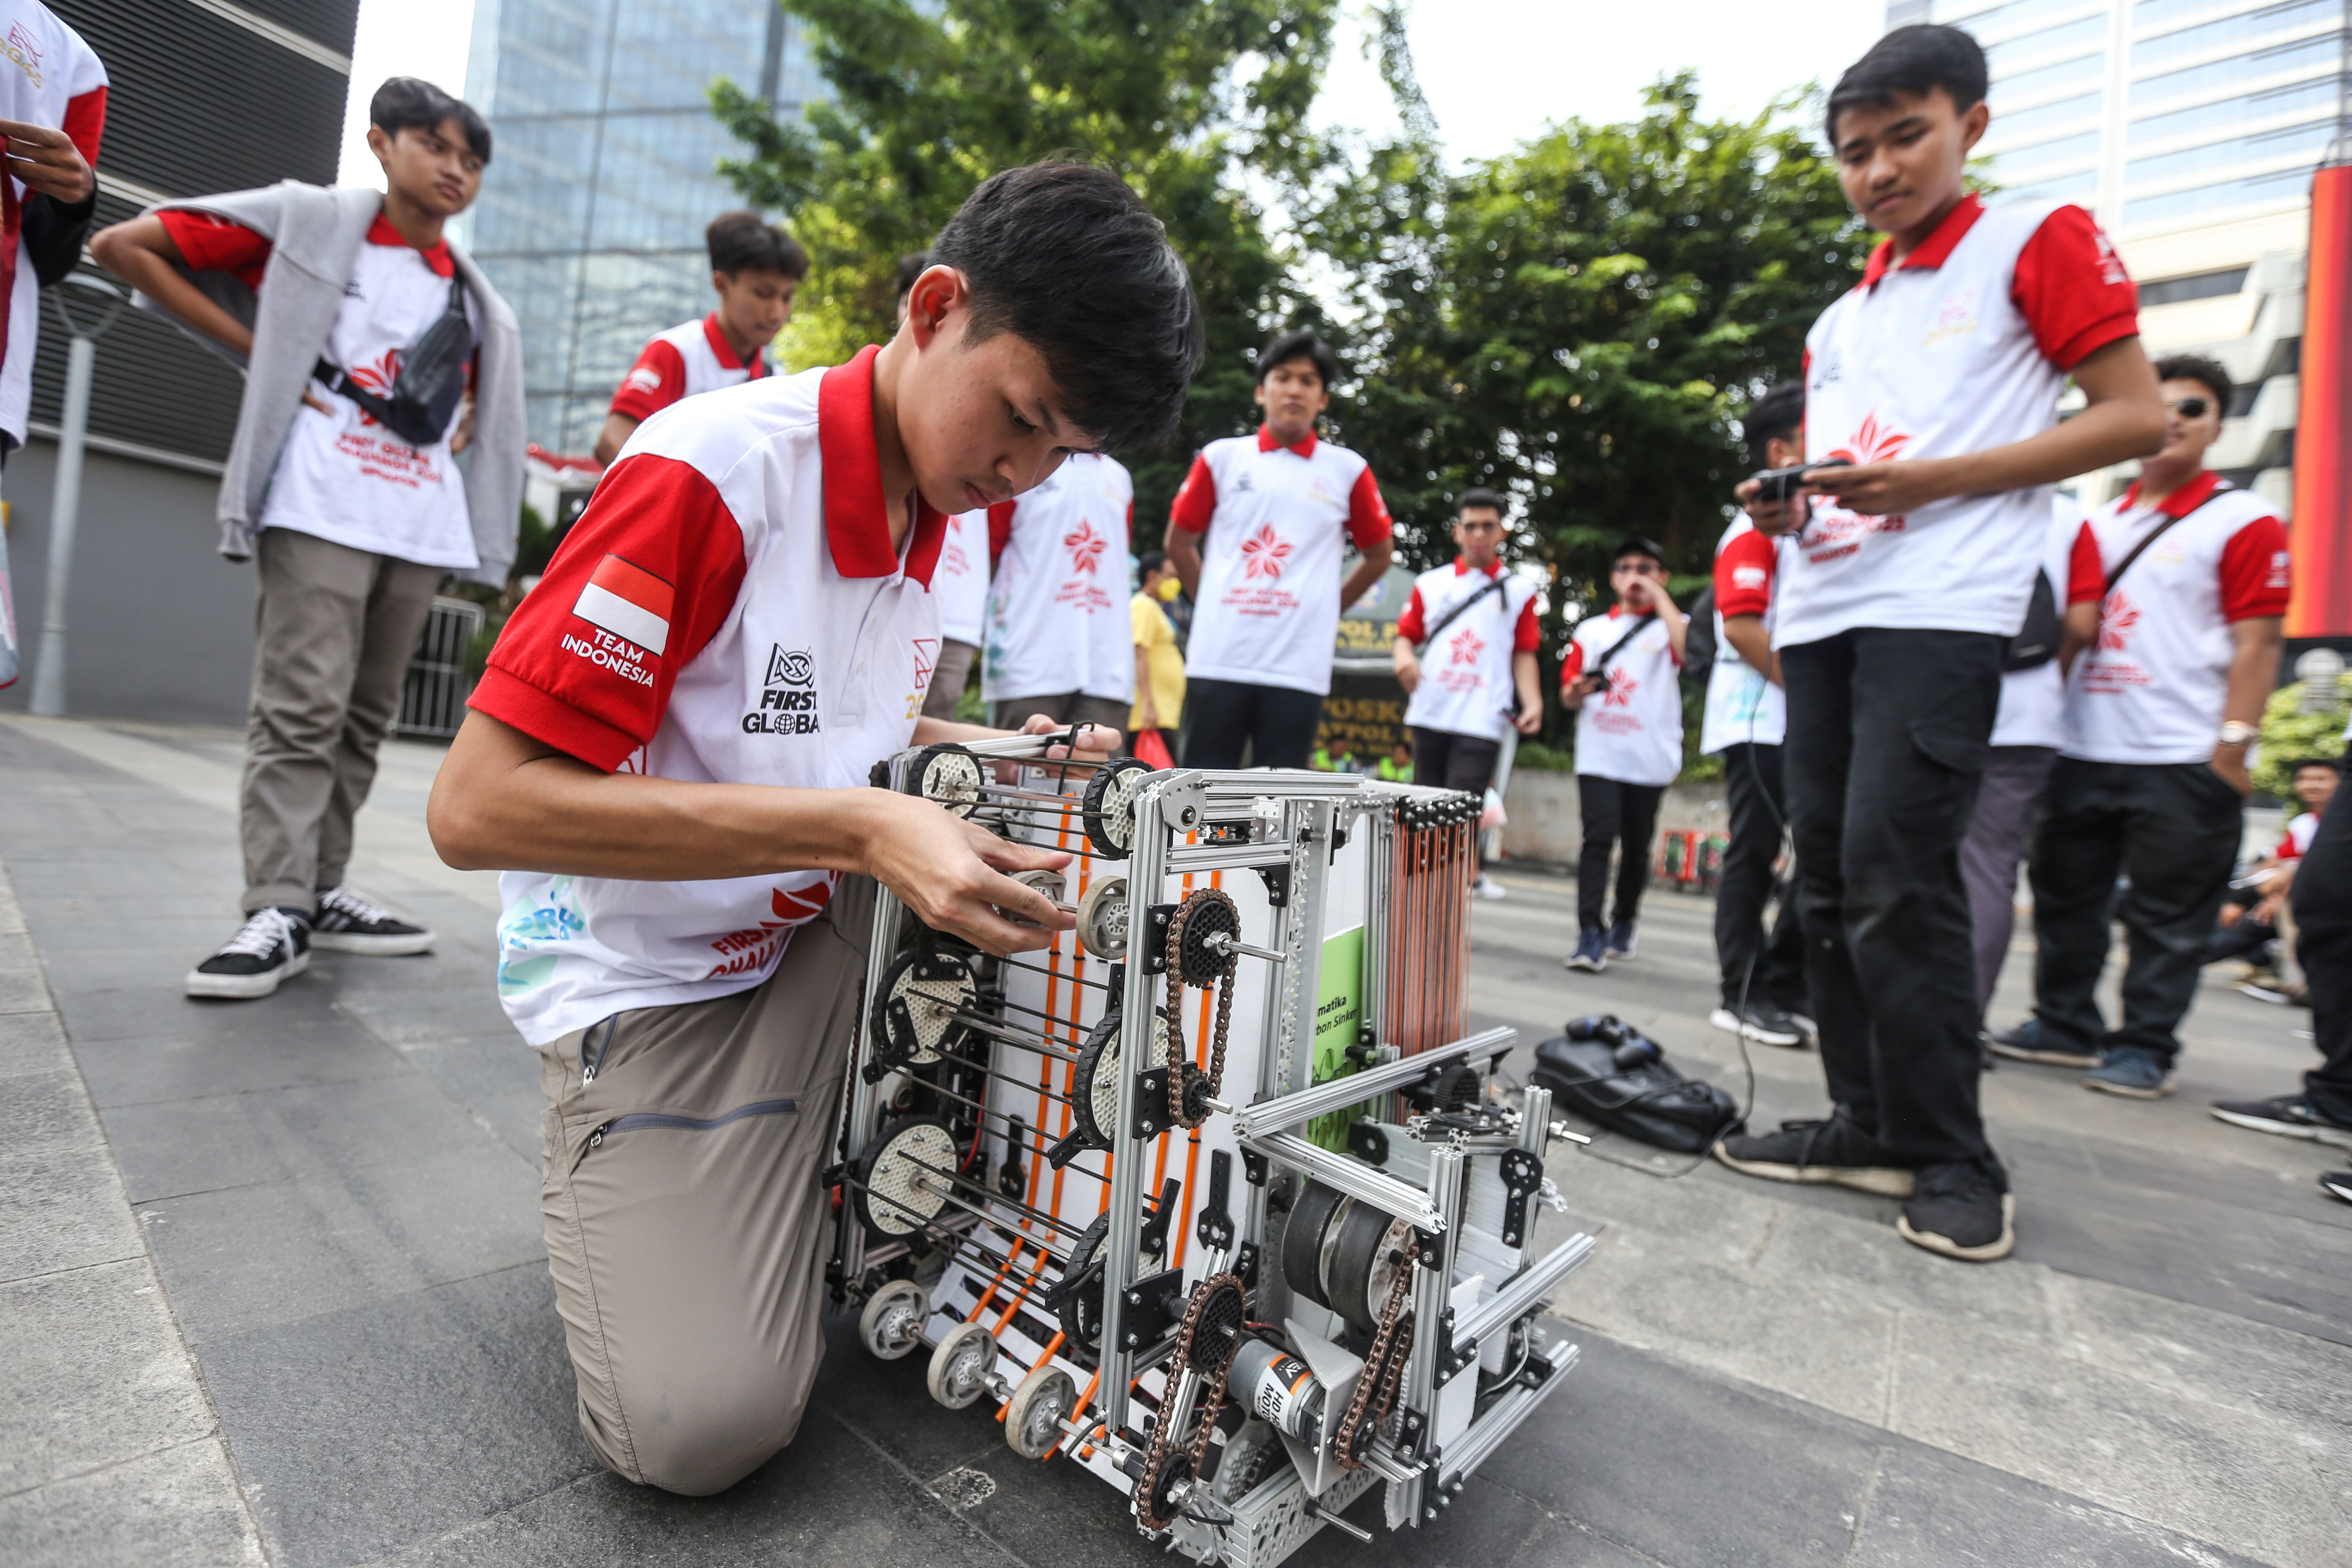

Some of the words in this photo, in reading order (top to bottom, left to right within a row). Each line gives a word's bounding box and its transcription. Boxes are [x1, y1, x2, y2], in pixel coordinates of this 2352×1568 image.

[594, 628, 644, 664] TEAM
[561, 633, 653, 687] INDONESIA
[742, 712, 820, 735] GLOBA
[1318, 996, 1347, 1018] matika
[1316, 1021, 1332, 1036] bon
[1334, 1009, 1358, 1027] Sinker
[1262, 1382, 1275, 1420] MOTO
[1272, 1391, 1284, 1413] HD
